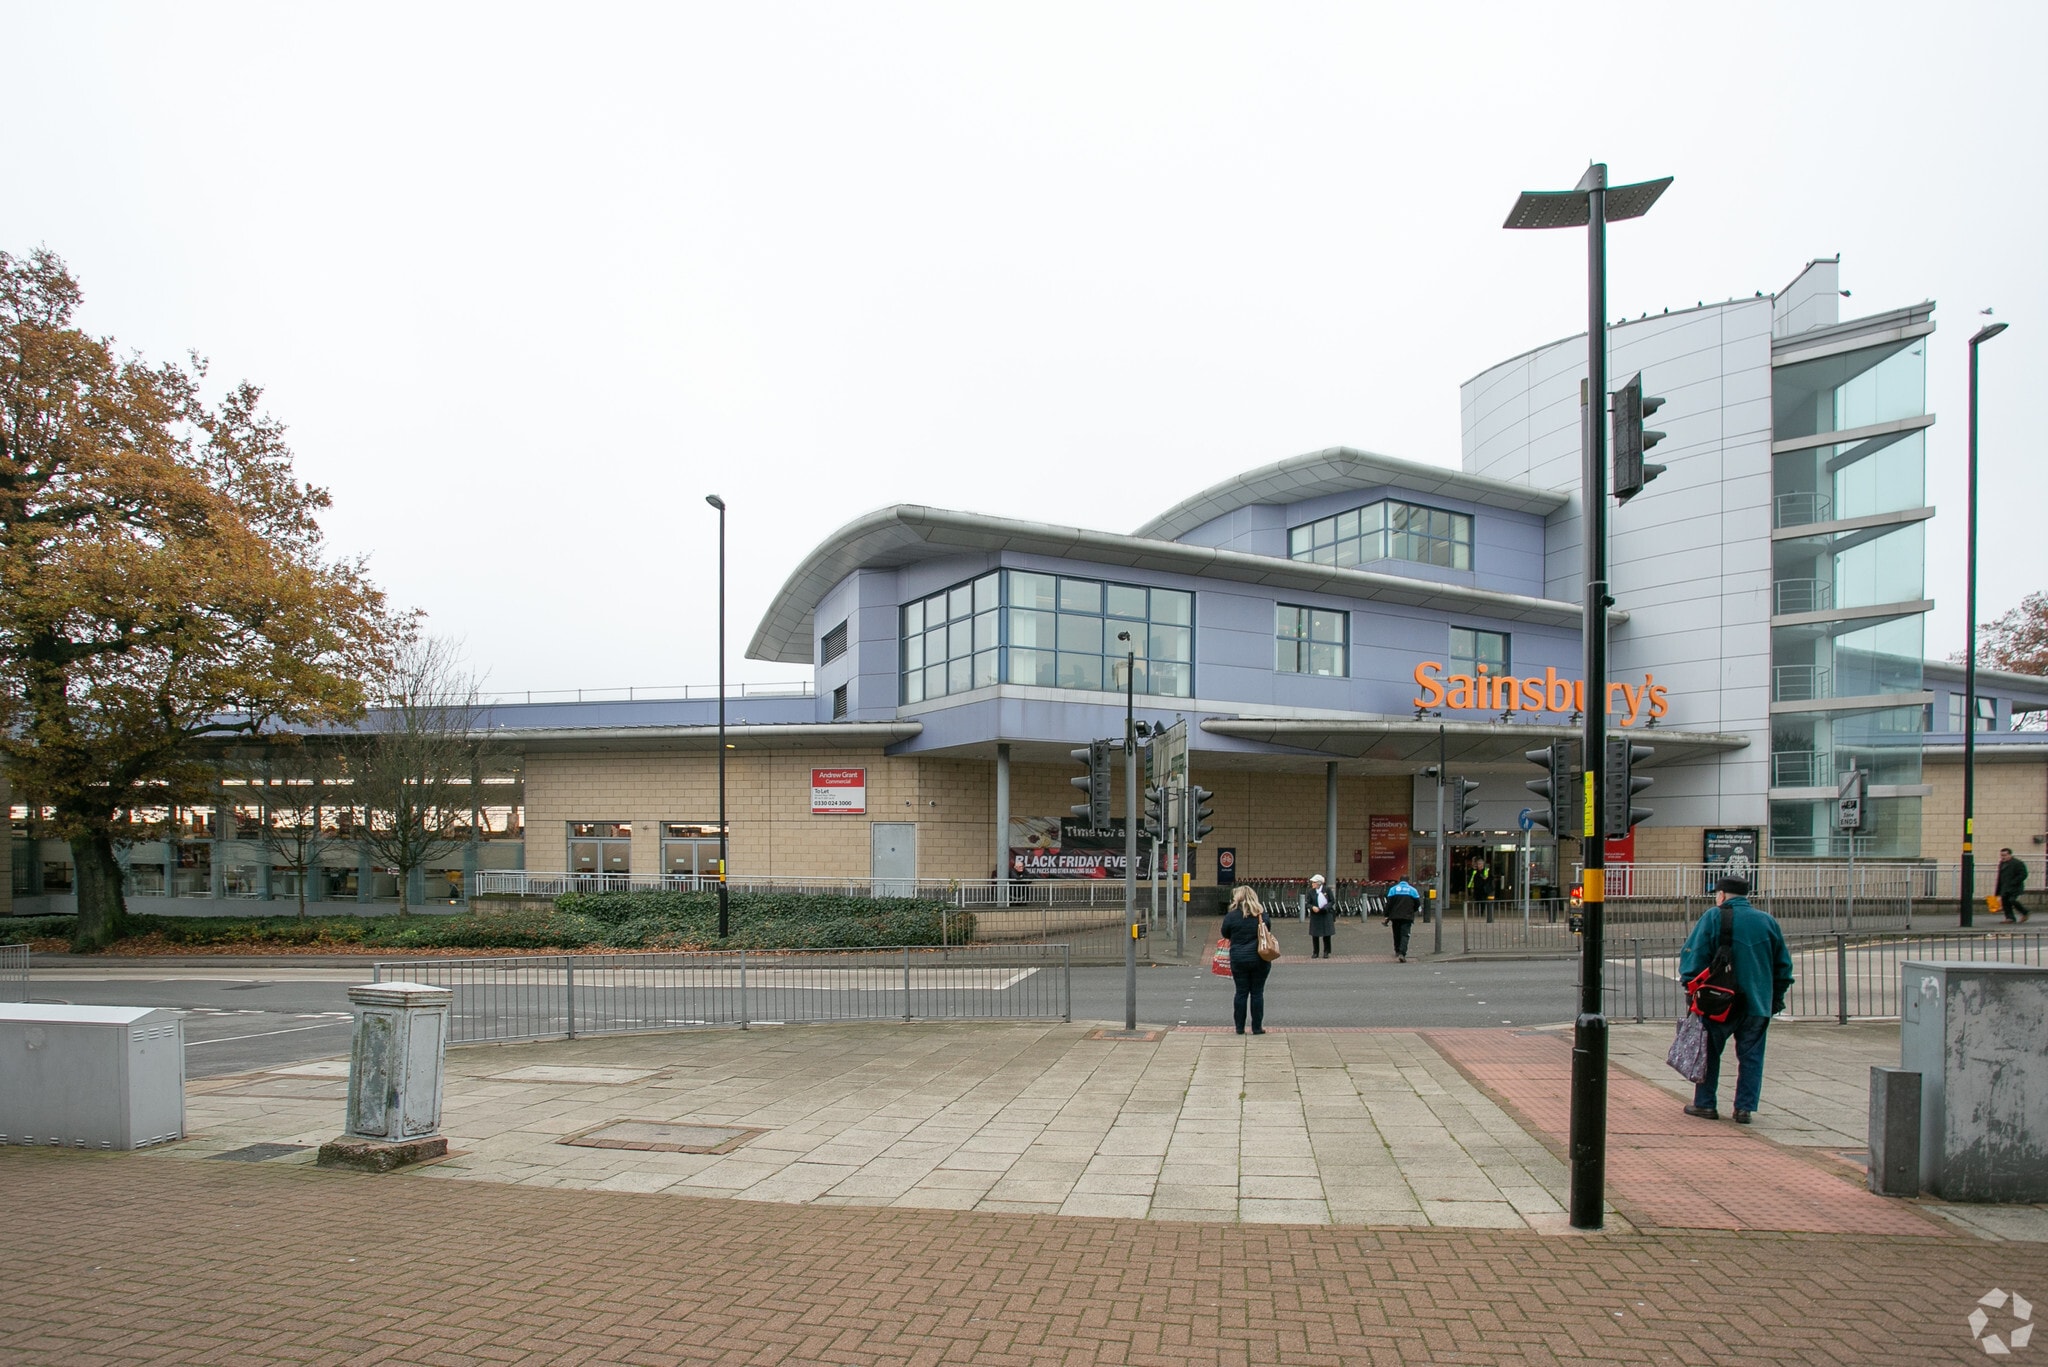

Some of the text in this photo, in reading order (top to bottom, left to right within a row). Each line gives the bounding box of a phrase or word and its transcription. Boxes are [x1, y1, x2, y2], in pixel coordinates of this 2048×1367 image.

[1065, 826, 1095, 837] Time
[1059, 856, 1102, 867] FRIDAY
[1104, 856, 1142, 867] EVET
